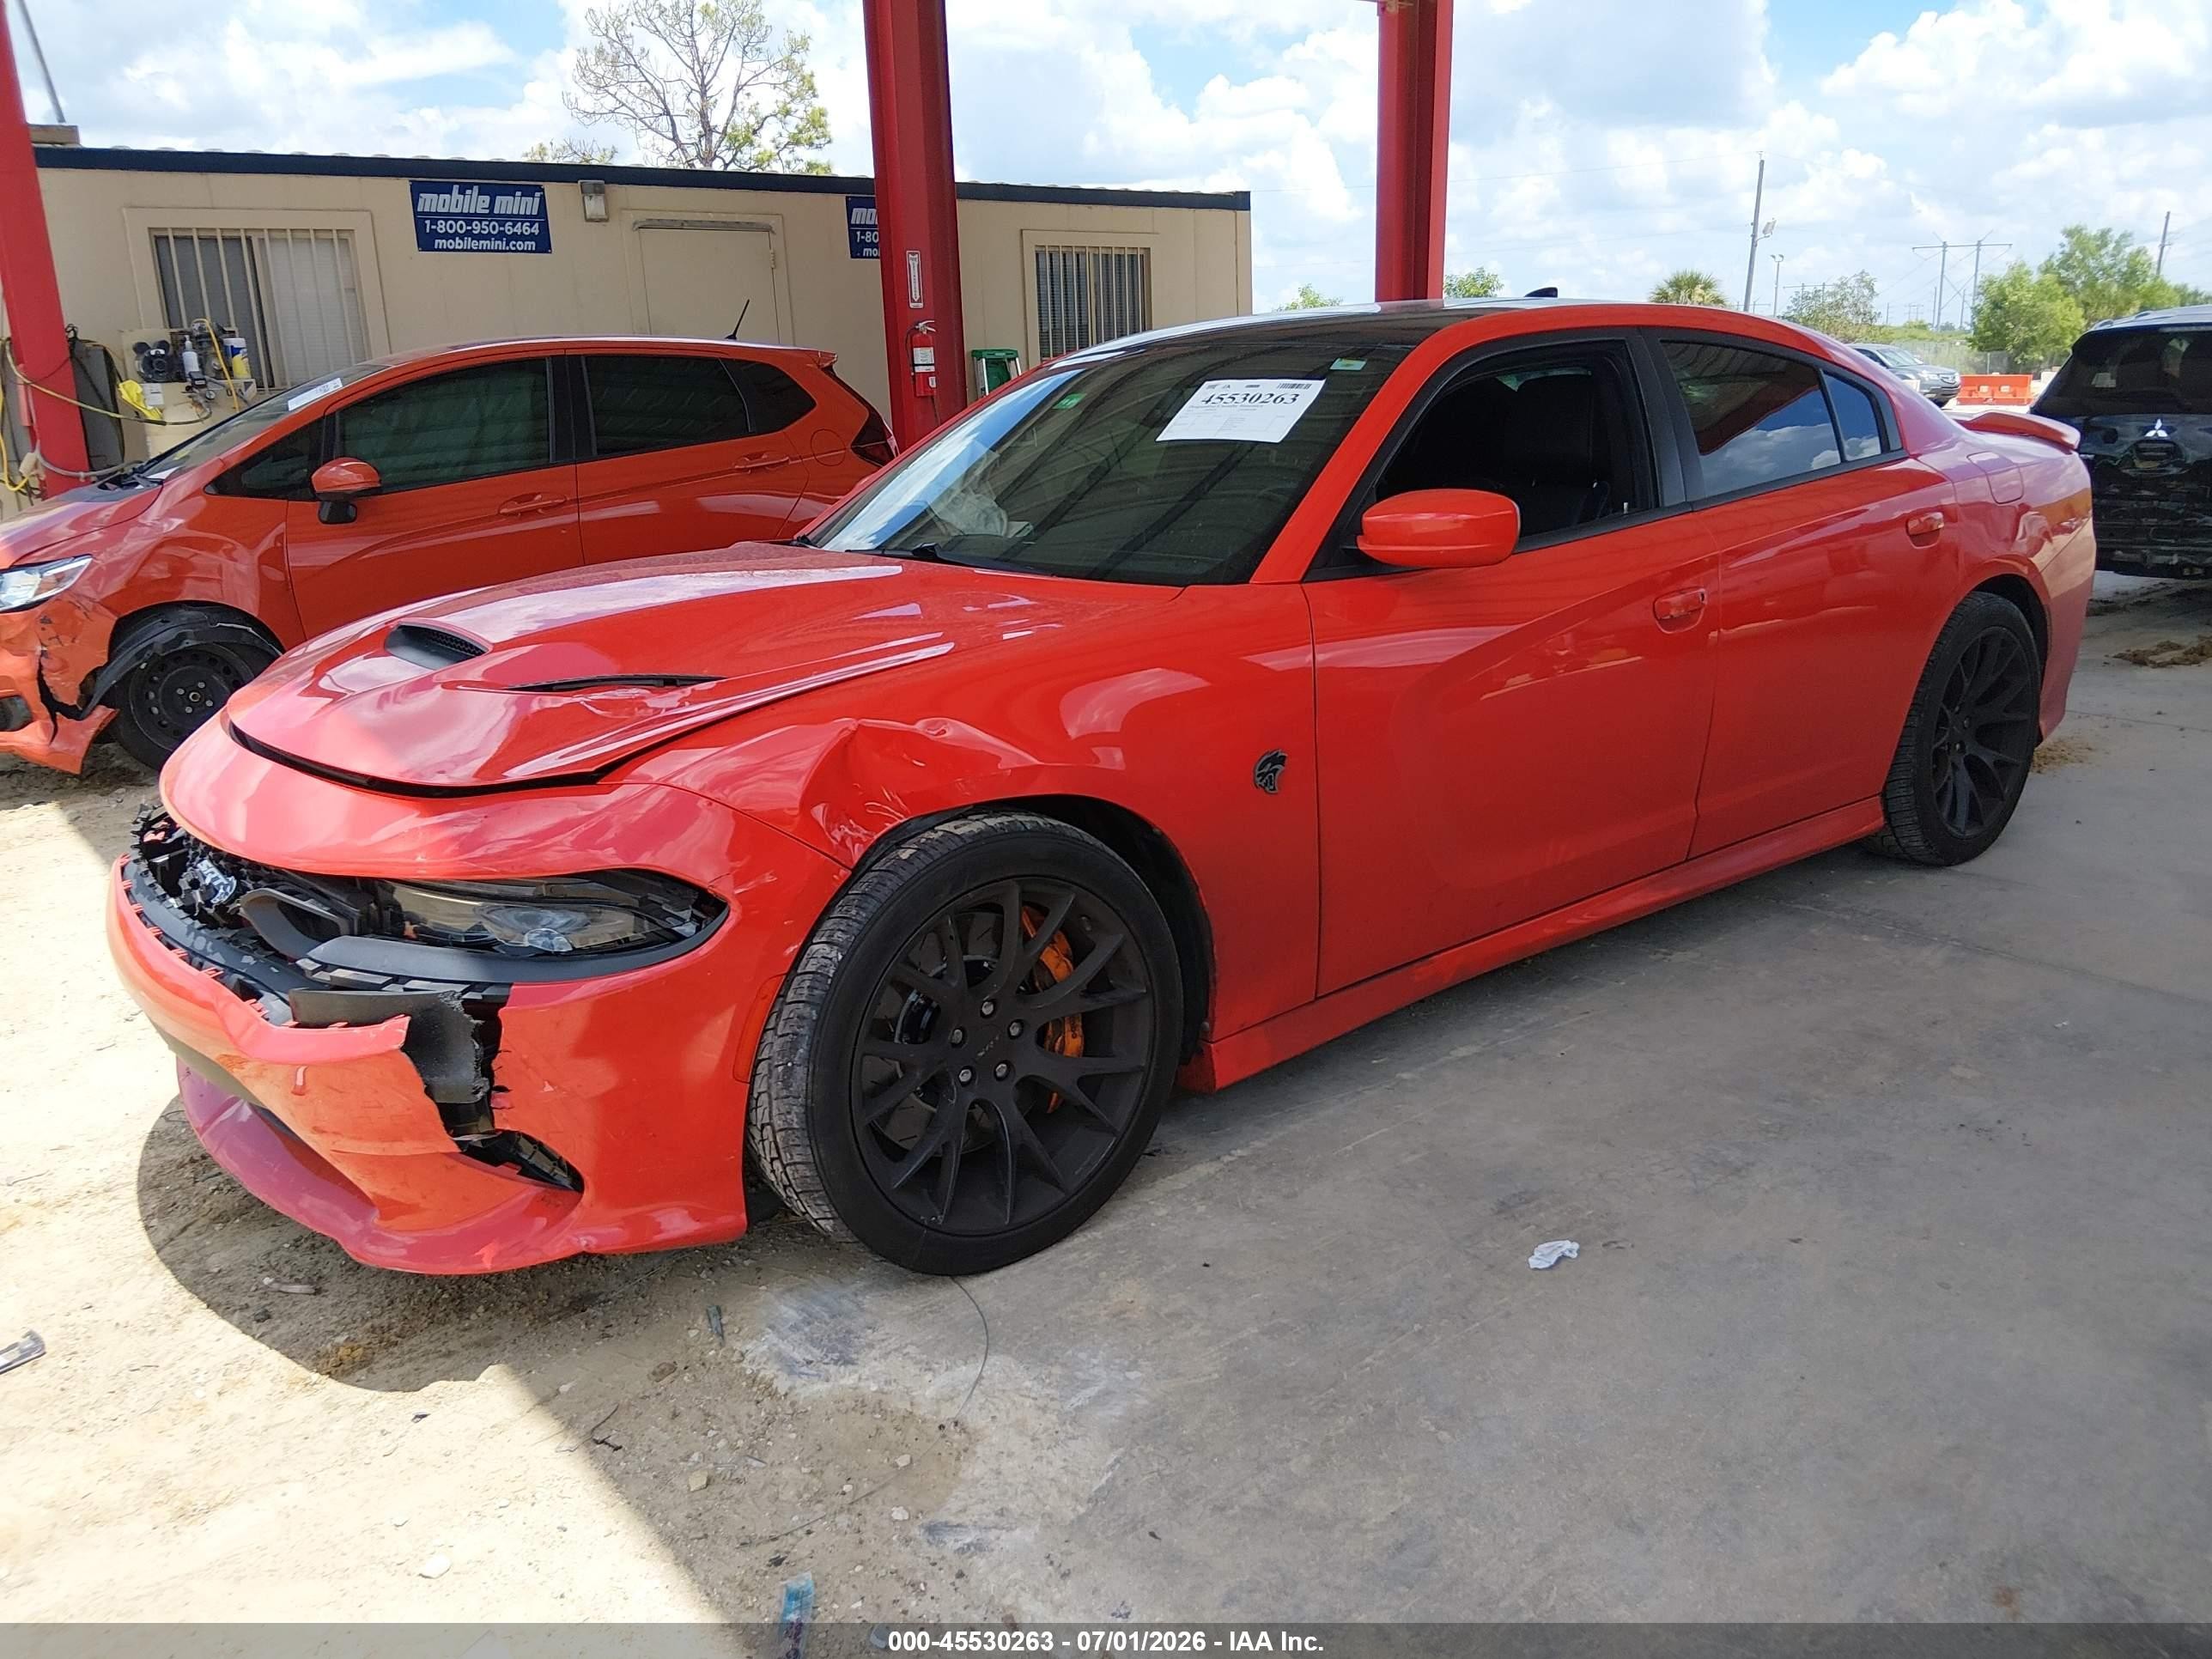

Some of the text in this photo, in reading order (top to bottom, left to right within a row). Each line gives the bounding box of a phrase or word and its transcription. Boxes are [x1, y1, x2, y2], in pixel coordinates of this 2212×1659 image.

[416, 185, 542, 216] mobile mini
[424, 220, 540, 236] 1-800-950-6464
[434, 237, 537, 252] mobilemini.com
[1201, 392, 1301, 404] 45530263
